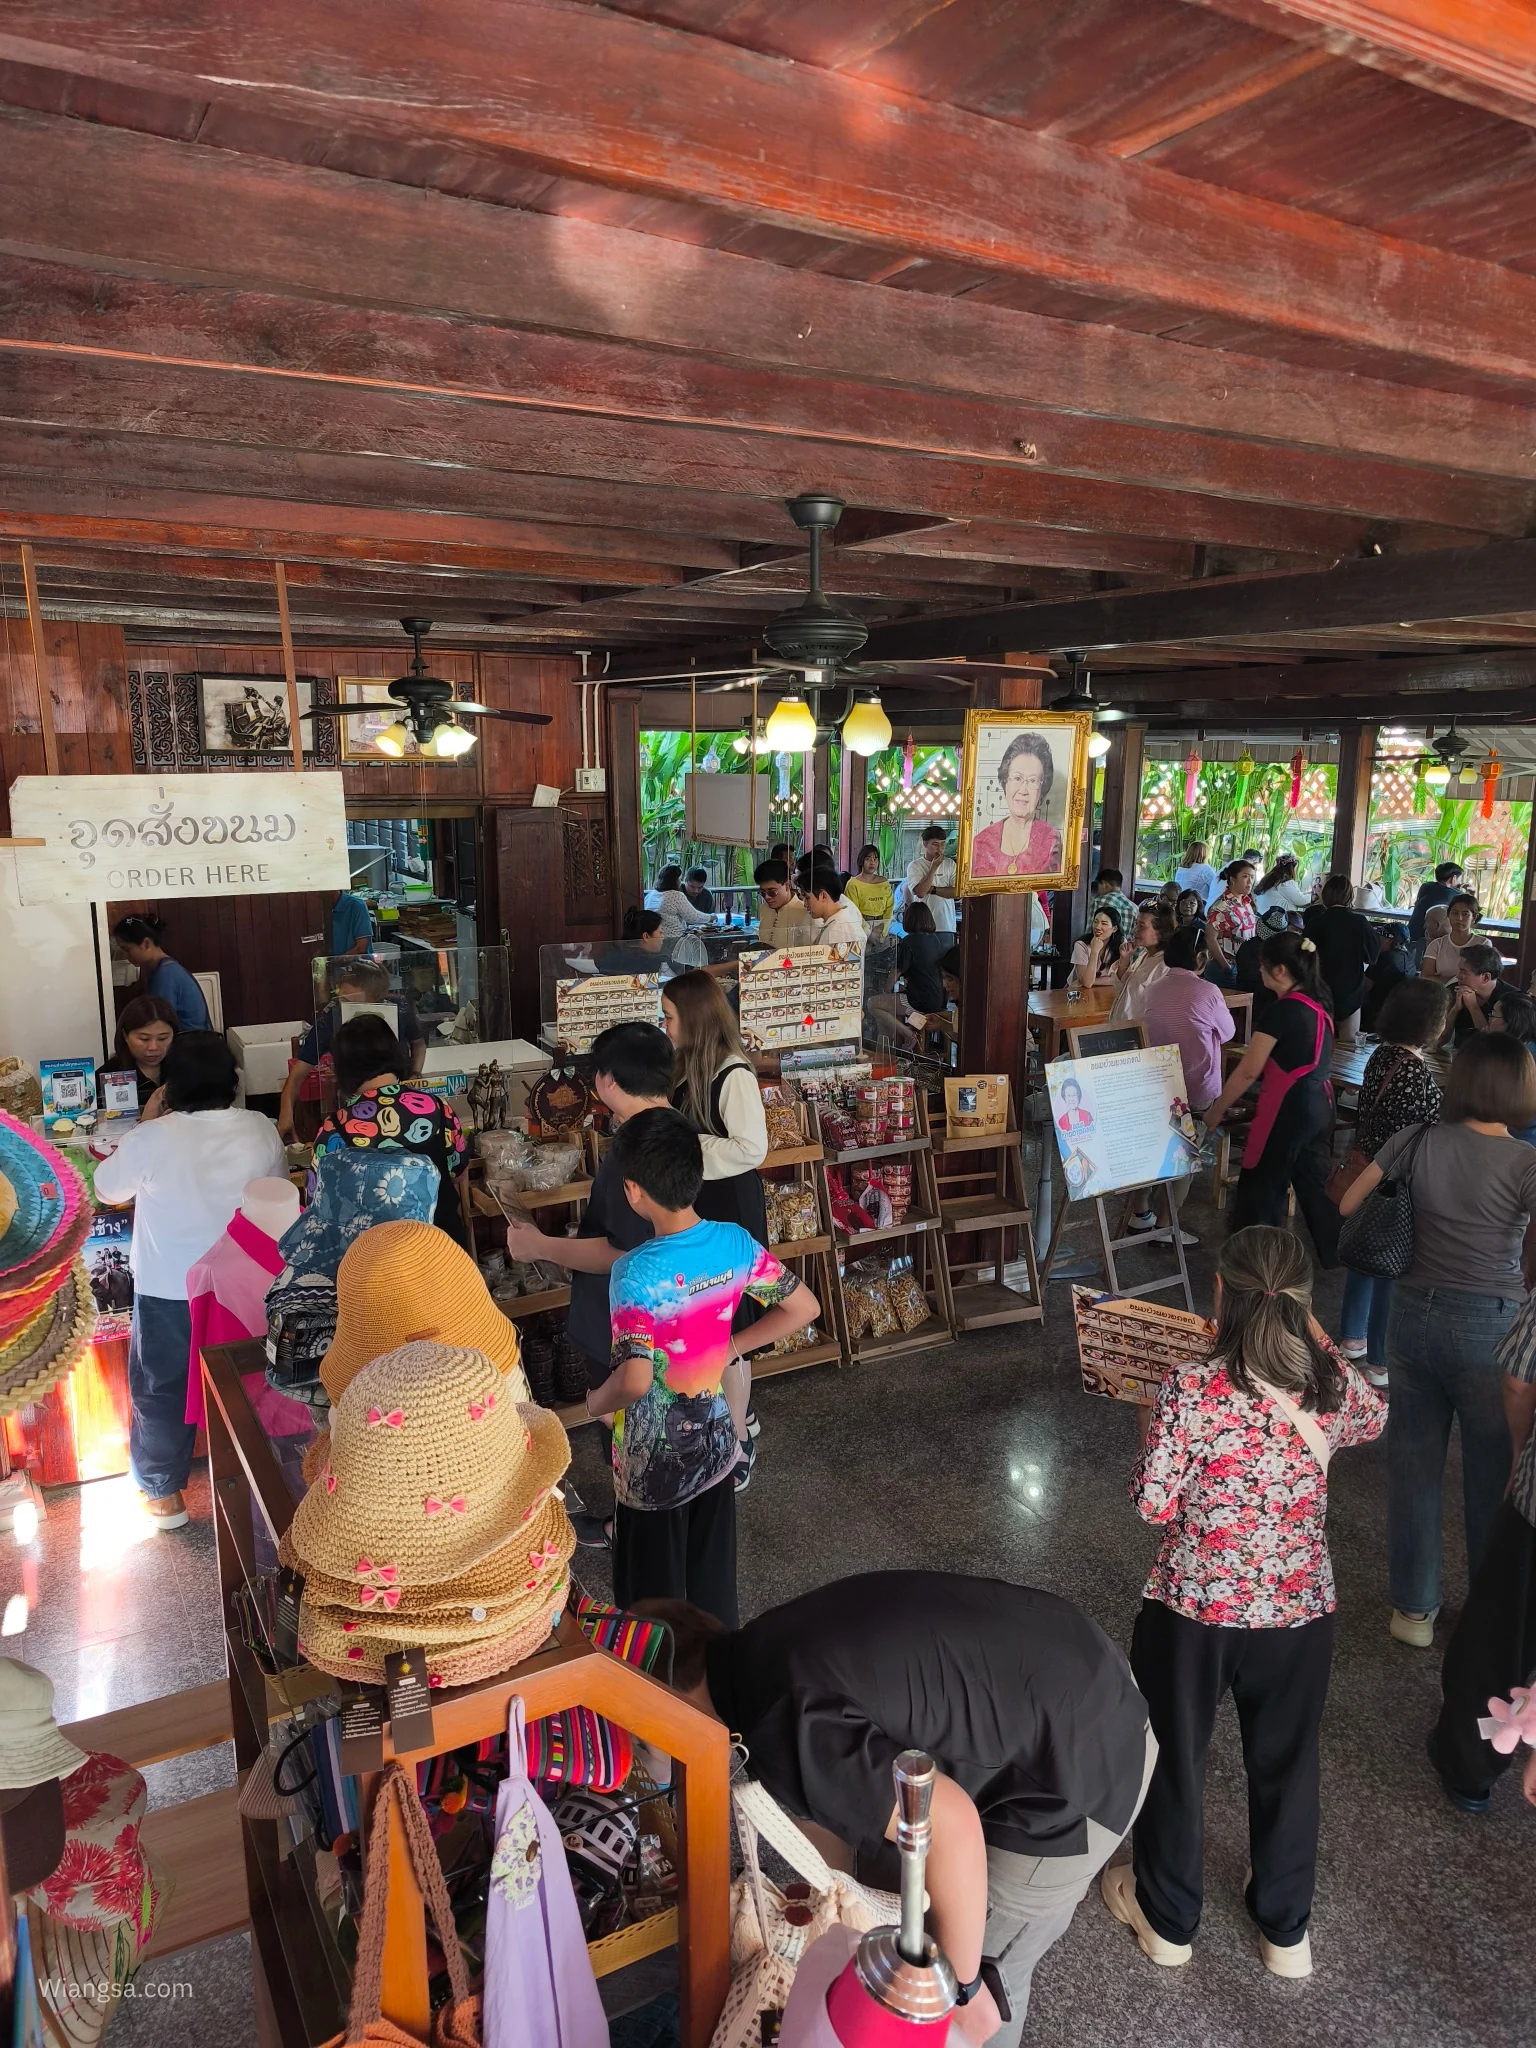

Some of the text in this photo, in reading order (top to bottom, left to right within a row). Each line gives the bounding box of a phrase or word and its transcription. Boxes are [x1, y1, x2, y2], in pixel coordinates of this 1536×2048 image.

[68, 787, 296, 870] จุดสั่งขนม
[107, 863, 270, 889] ORDER HERE
